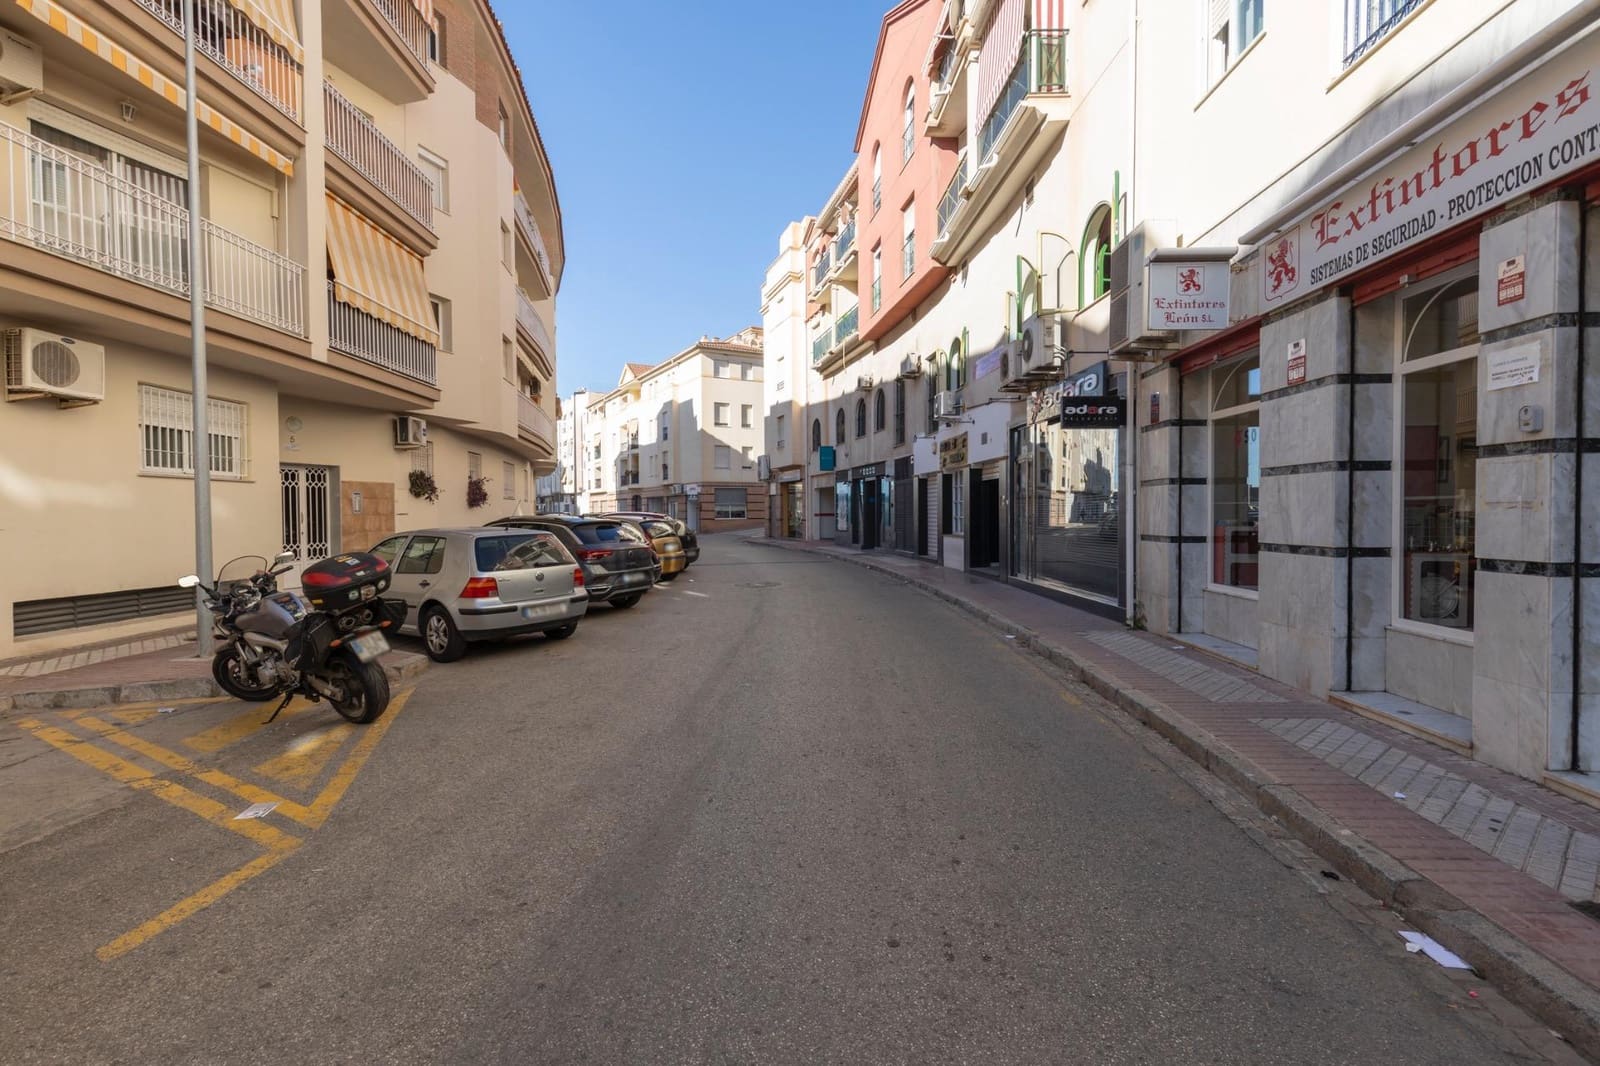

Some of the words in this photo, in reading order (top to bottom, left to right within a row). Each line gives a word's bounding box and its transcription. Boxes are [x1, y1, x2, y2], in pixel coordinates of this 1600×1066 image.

[1310, 250, 1354, 285] SISTEMAS
[1355, 242, 1370, 264] DE
[1371, 209, 1437, 256] SEGURIDAD
[1447, 152, 1543, 220] PROTECCION
[1548, 122, 1600, 171] CONT
[1311, 70, 1591, 250] Extintores
[1153, 297, 1226, 309] Extintores
[1164, 311, 1198, 323] León
